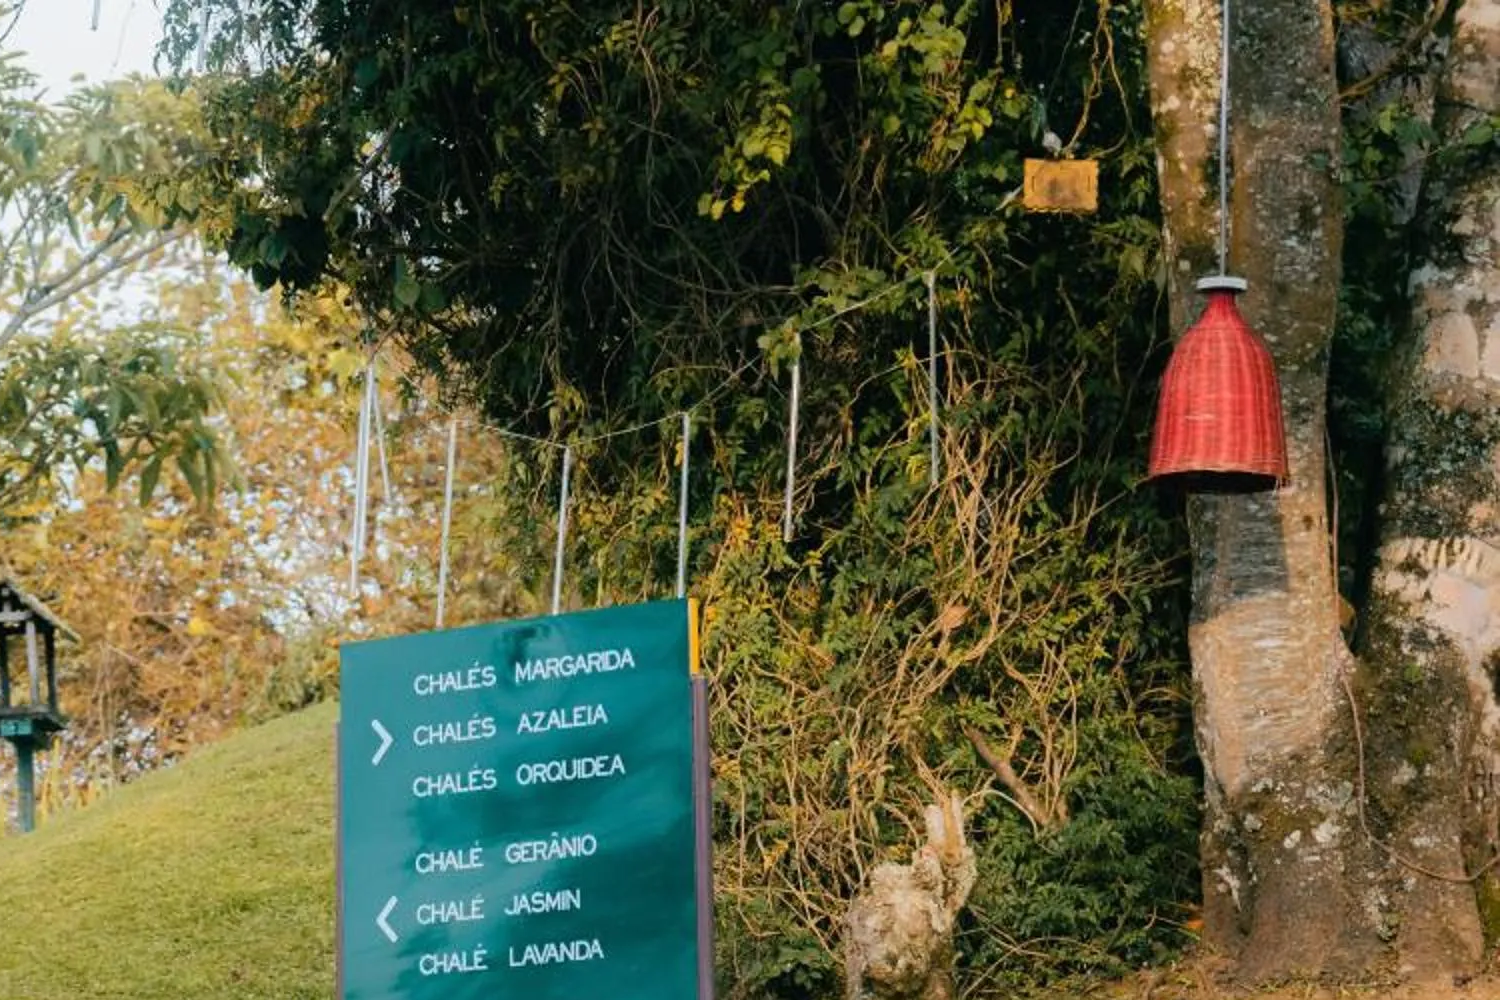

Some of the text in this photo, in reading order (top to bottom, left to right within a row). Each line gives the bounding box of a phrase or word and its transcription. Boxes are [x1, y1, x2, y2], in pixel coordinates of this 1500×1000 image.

[413, 647, 635, 696] CHALÉS MARGARIDA
[412, 703, 609, 748] CHALÉS AZALEIA
[411, 753, 625, 798] CHALÉS ORQUIDEA
[415, 832, 598, 875] CHALÉ GERÂNIO
[415, 889, 581, 925] CHALÉ JASMIN
[419, 938, 604, 976] CHALÉ LAVANDA
